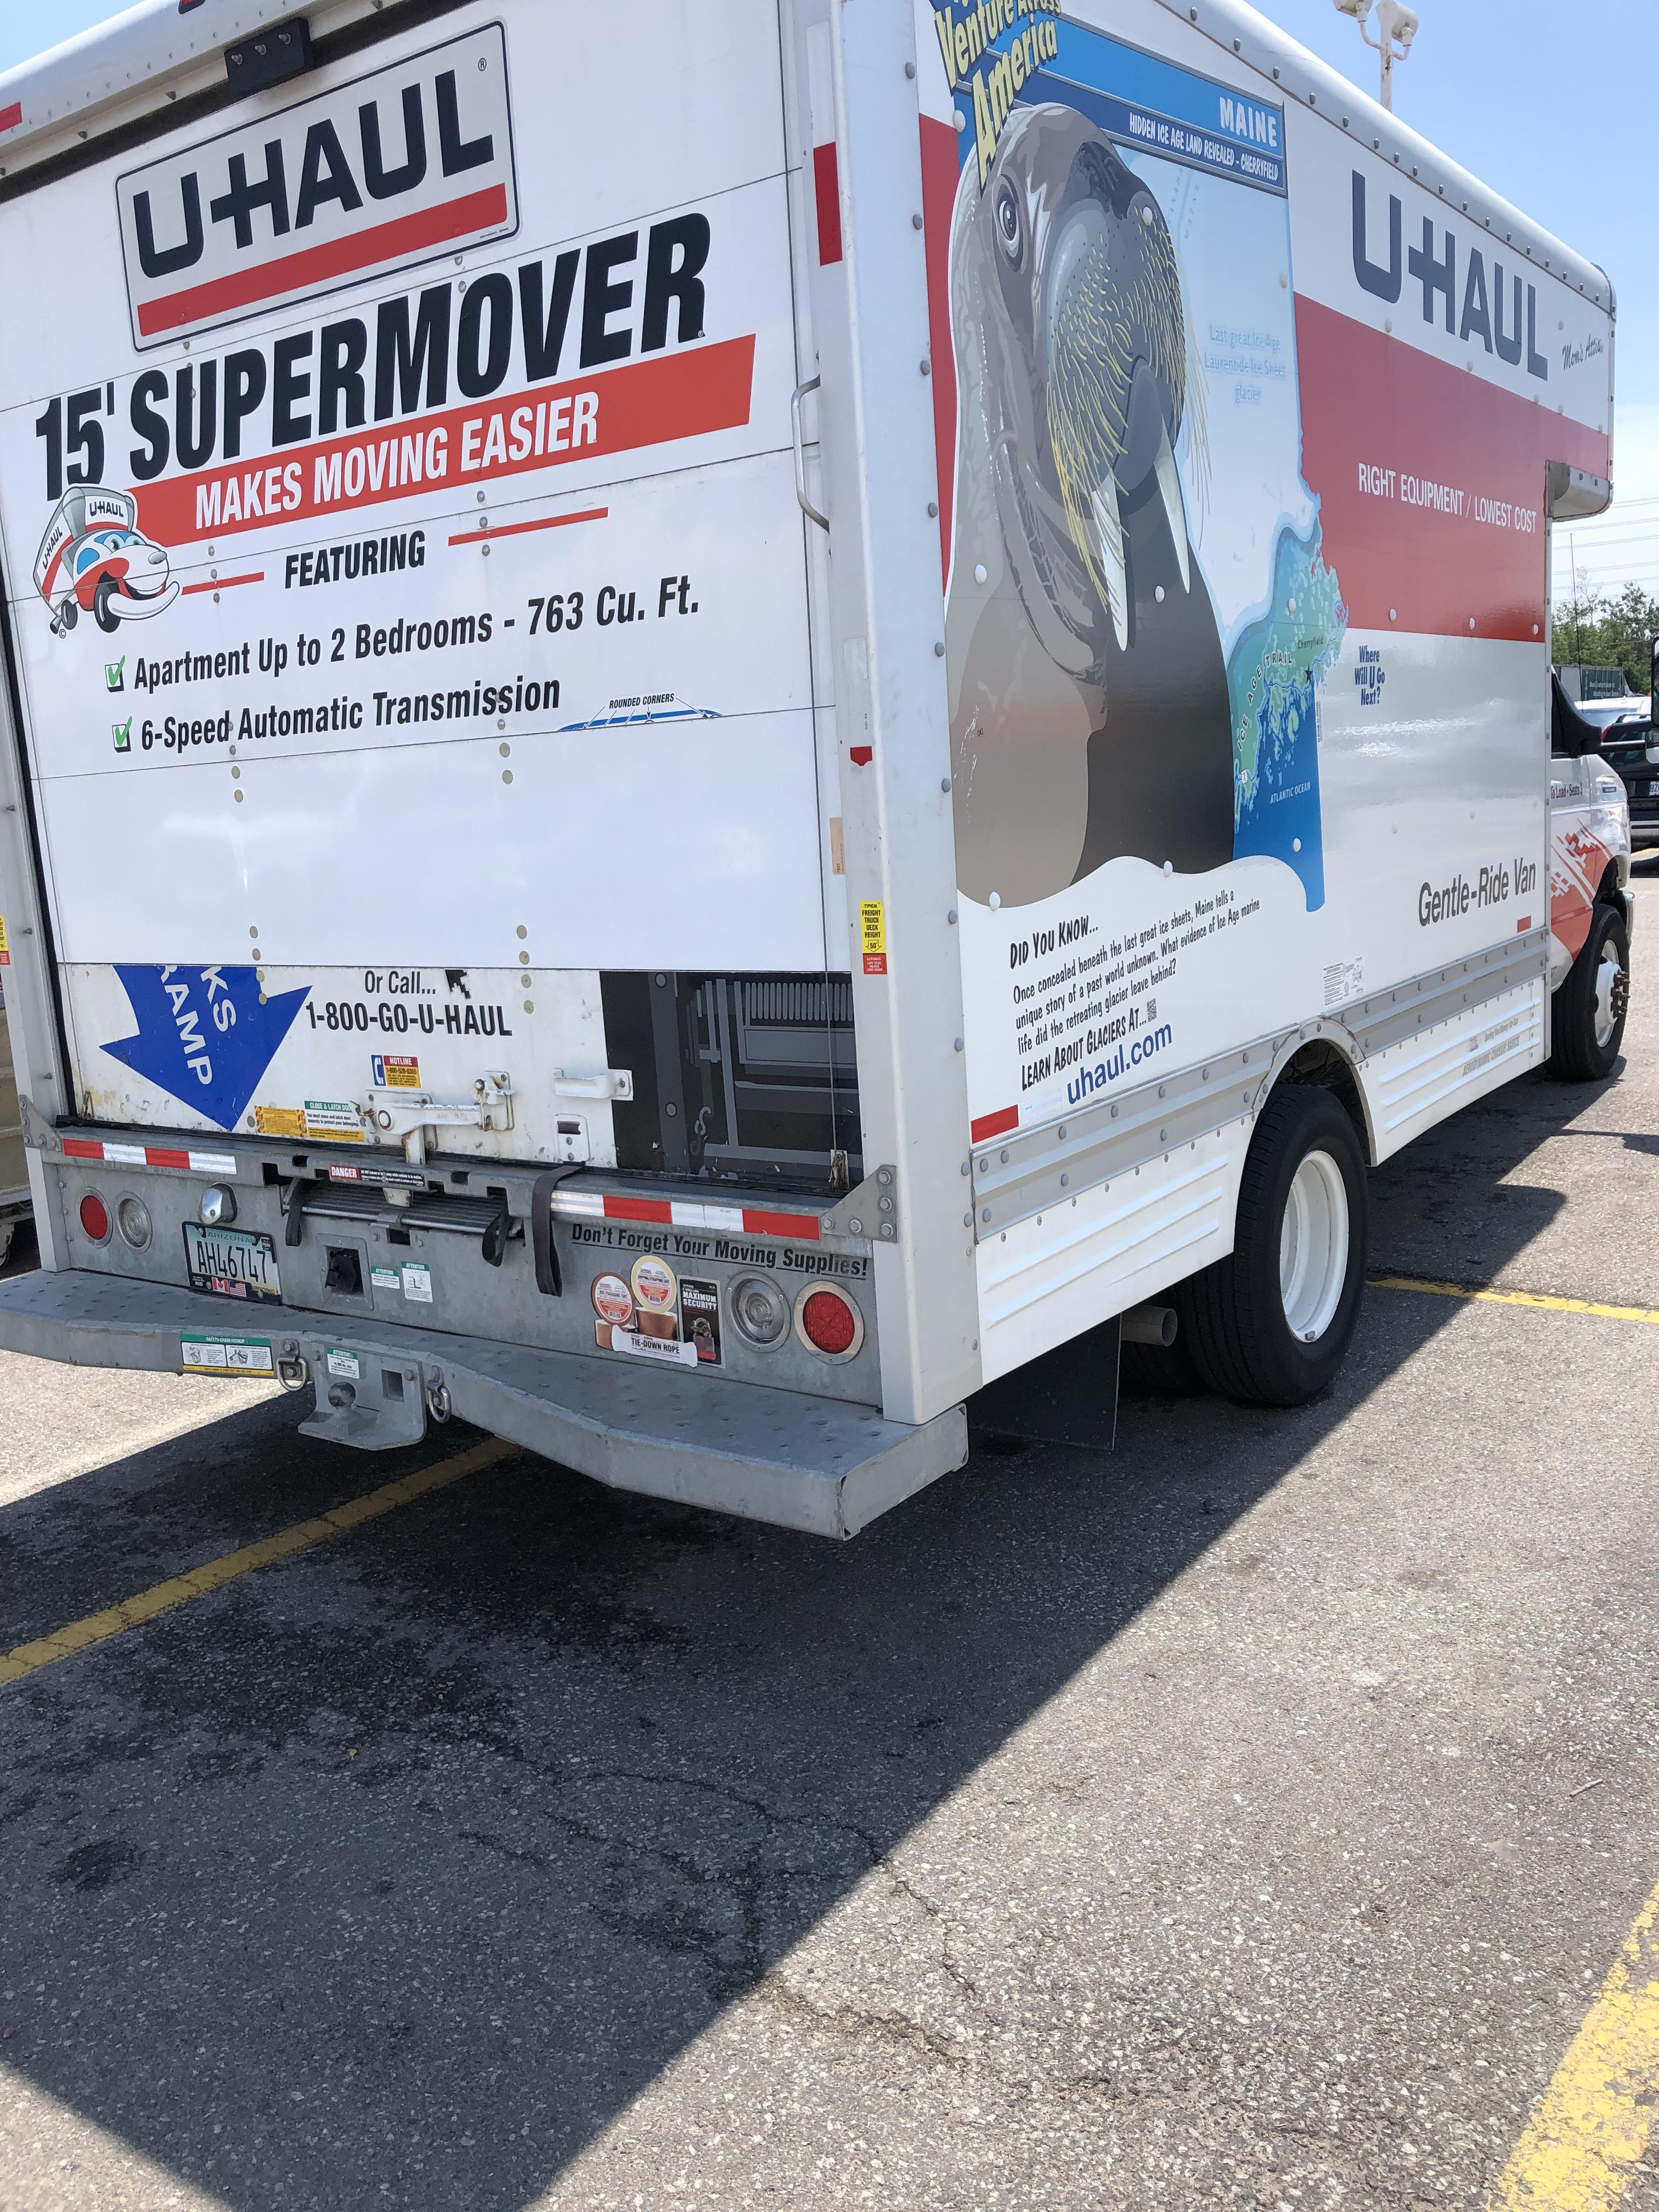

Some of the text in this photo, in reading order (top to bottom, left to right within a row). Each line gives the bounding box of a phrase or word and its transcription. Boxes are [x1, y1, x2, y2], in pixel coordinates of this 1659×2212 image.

[972, 13, 1058, 188] America
[1220, 97, 1277, 147] MAINE
[1130, 112, 1278, 181] HIDDEN ICE AGE LAND REVEALED CHERRYFIELD
[133, 70, 494, 278] U-HAUL
[1352, 169, 1548, 381] U-HAUL
[36, 212, 710, 501] 15' SUPERMOVER
[1210, 324, 1280, 354] Last great Ice Age
[1204, 351, 1286, 377] Laurentide Ice Sheet
[1235, 383, 1261, 404] glacier
[195, 391, 600, 530] MAKES MOVING EASIER
[89, 501, 123, 517] U-HAUL
[1359, 462, 1536, 534] RIGHT EQUIPMENT LOWEST COST
[42, 527, 63, 569] U-HAUL
[285, 531, 426, 589] FEATURING
[134, 575, 699, 694] Apartment Up to 2 Bedrooms 763 Cu. Ft.
[1298, 636, 1323, 649] Cherryfield
[1359, 645, 1380, 663] Where
[1355, 666, 1385, 689] Will U Go
[1361, 686, 1380, 706] Next?
[141, 675, 560, 754] 6-Speed Automatic Transmission
[609, 693, 674, 709] ROUNDED CORNERS
[1238, 652, 1292, 752] ICE AGE TRAIL
[1270, 781, 1311, 804] ATLANTIC OCEAN
[1650, 783, 1659, 793] BZ
[1419, 857, 1536, 927] Gentle-Ride Van
[1011, 915, 1098, 969] DID YOU KNOW...
[1013, 889, 1234, 1004] Once concealed beneath the last great ice sheets, Maine tells a
[365, 970, 436, 995] Or Call...
[1016, 899, 1260, 1029] unique story of a past world unknown. What evidence of Ice Age marine
[306, 1001, 513, 1036] 1-800-GO-U-HAUL
[1018, 958, 1176, 1055] life did the retreating glacier leave behind?
[390, 1057, 413, 1065] HOTLINE
[1022, 1053, 1051, 1091] LEARN
[1054, 1037, 1084, 1074] ABOUT
[1087, 1015, 1126, 1055] GLACIERS
[1067, 1024, 1172, 1104] uhaul.com
[331, 1166, 357, 1178] DANGER
[207, 1232, 252, 1243] ARIZONA
[572, 1223, 867, 1276] Don't Forget Your Moving Supplies!
[197, 1241, 267, 1284] AH46747
[682, 1291, 716, 1303] MAXIMUM
[682, 1299, 717, 1310] SECURITY
[631, 1338, 662, 1350] TIE-DOWN
[663, 1344, 680, 1354] ROPE
